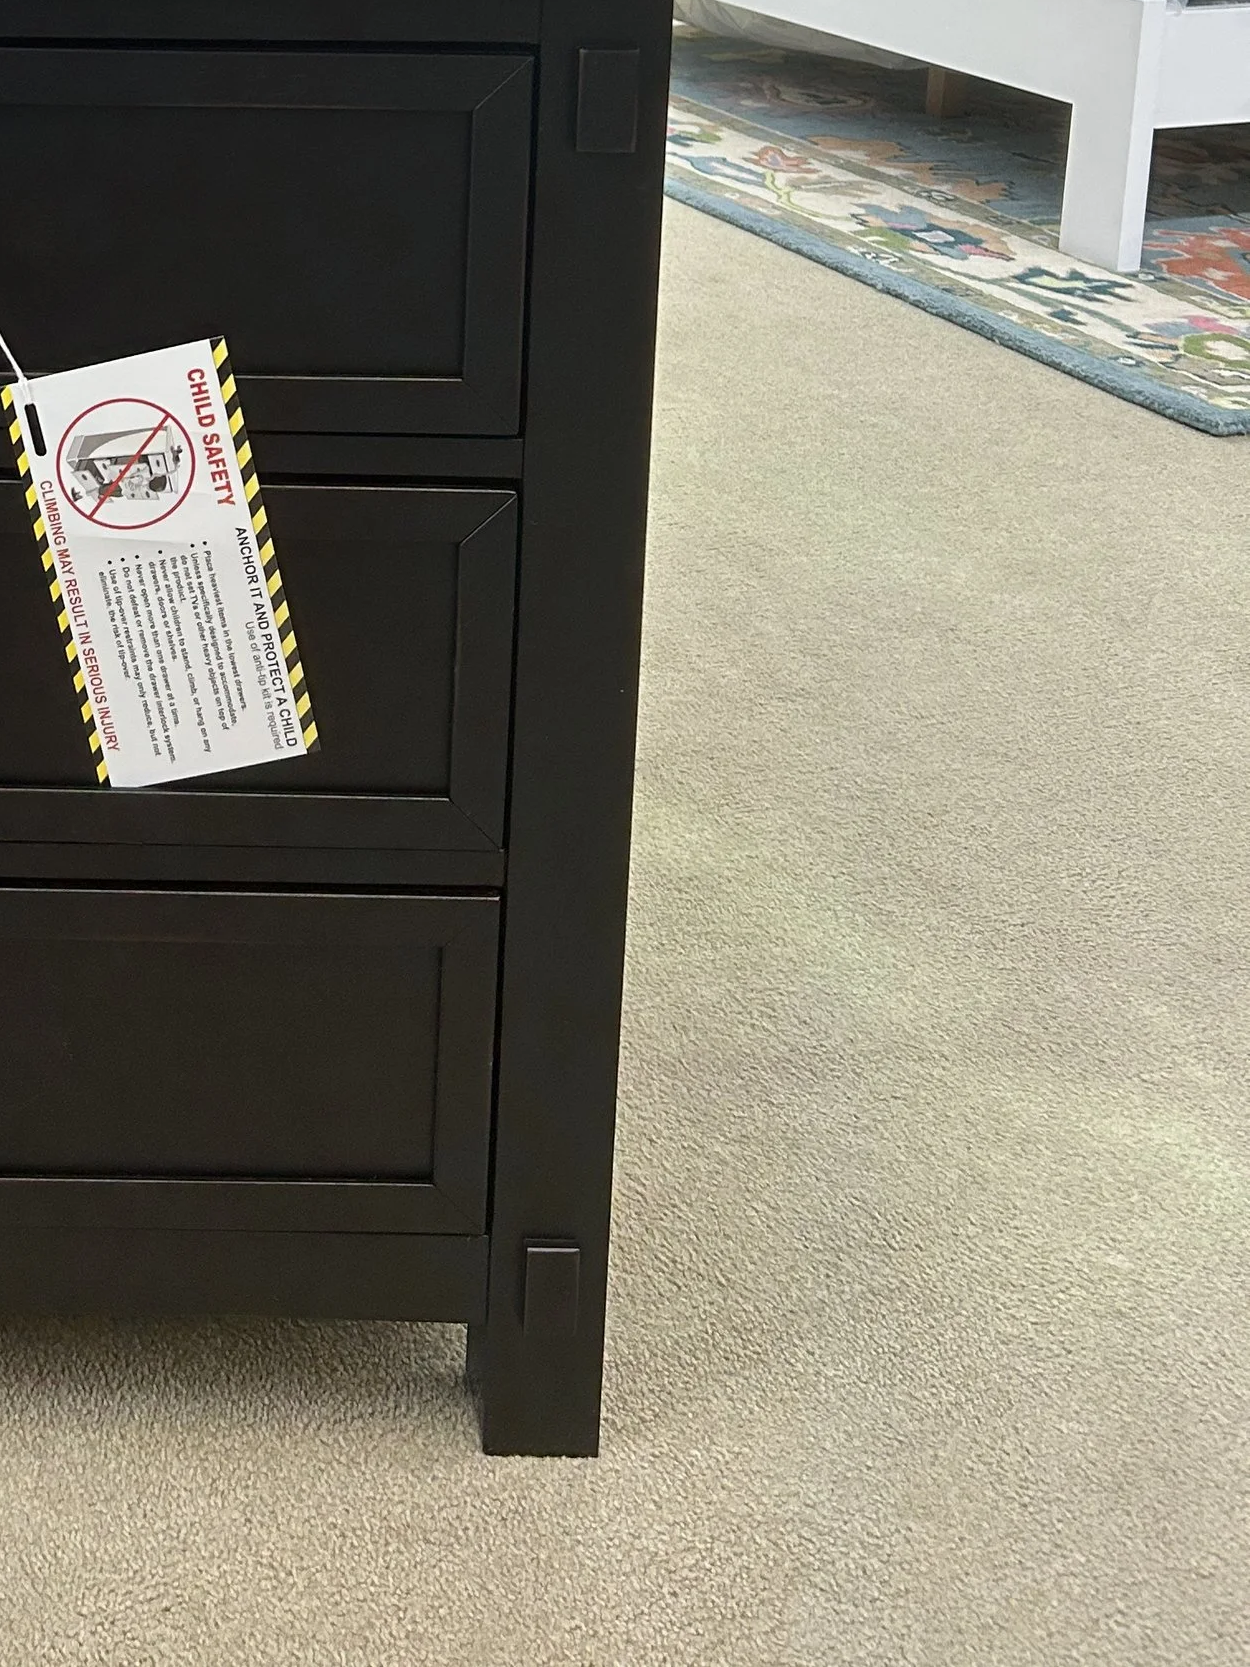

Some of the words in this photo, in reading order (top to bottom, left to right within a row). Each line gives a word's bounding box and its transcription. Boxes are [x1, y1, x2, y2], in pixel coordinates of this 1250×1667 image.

[186, 368, 216, 428] CHILD
[202, 432, 236, 506] SAFETY
[39, 480, 67, 547] CLIMBING
[56, 547, 76, 576] MAY
[202, 549, 214, 573] Place
[234, 527, 260, 586] ANCHOR
[134, 563, 146, 588] Never
[158, 558, 170, 583] Never
[139, 587, 151, 609] open
[164, 583, 176, 605] allow
[208, 572, 224, 607] heaviest
[249, 586, 264, 599] IT
[64, 578, 89, 629] RESULT
[114, 594, 128, 626] tip-over
[189, 551, 203, 580] Unless
[196, 580, 214, 625] specifically
[208, 625, 224, 662] designed
[252, 602, 270, 631] AND
[145, 609, 156, 630] more
[156, 595, 168, 620] doors
[165, 629, 178, 662] shelves.
[169, 605, 184, 638] children
[216, 606, 228, 629] items
[244, 620, 257, 642] Use
[77, 630, 93, 646] IN
[111, 623, 122, 640] risk
[122, 626, 138, 664] restraints
[150, 629, 161, 649] than
[196, 621, 207, 642] other
[180, 647, 193, 672] stand,
[201, 642, 213, 667] heavy
[249, 641, 262, 653] of
[82, 647, 108, 705] SERIOUS
[128, 593, 142, 619] defeat
[137, 628, 151, 659] remove
[148, 672, 161, 700] drawer
[155, 699, 171, 734] interlock
[228, 652, 241, 679] lowest
[252, 654, 268, 687] anti-tip
[260, 632, 286, 694] PROTECT
[136, 681, 147, 699] only
[159, 665, 172, 692] drawer
[186, 672, 198, 697] climb,
[207, 667, 220, 696] objects
[234, 678, 247, 711] drawers.
[261, 686, 273, 700] kit
[264, 700, 274, 710] is
[275, 696, 288, 707] A
[141, 699, 153, 729] reduce,
[195, 706, 206, 727] hang
[278, 708, 298, 747] CHILD
[96, 706, 120, 752] INJURY
[266, 710, 285, 751] required
